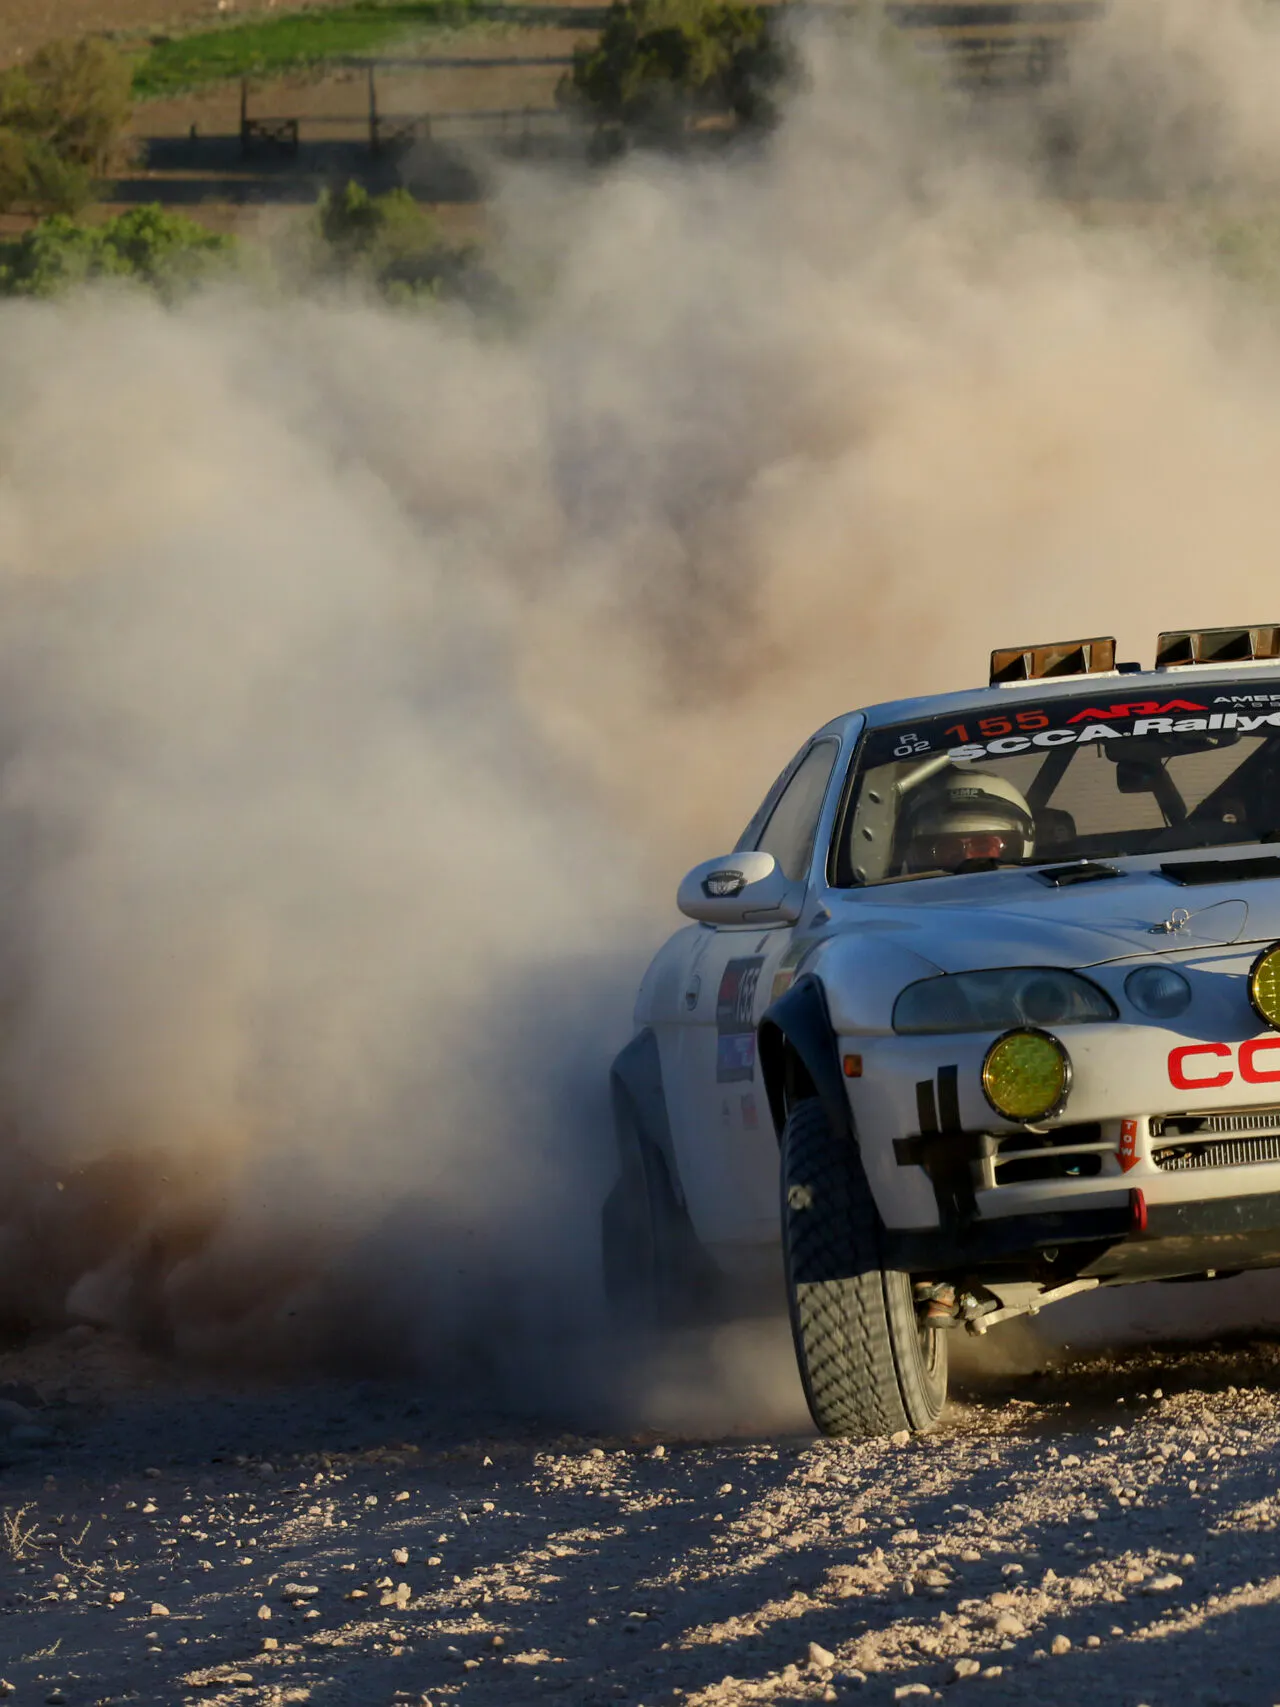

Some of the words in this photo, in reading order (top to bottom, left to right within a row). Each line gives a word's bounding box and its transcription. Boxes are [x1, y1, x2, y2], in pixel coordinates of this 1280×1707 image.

[1066, 699, 1209, 724] ARA
[900, 733, 918, 745] R
[944, 710, 1049, 742] 155
[1122, 1121, 1134, 1156] TOW
